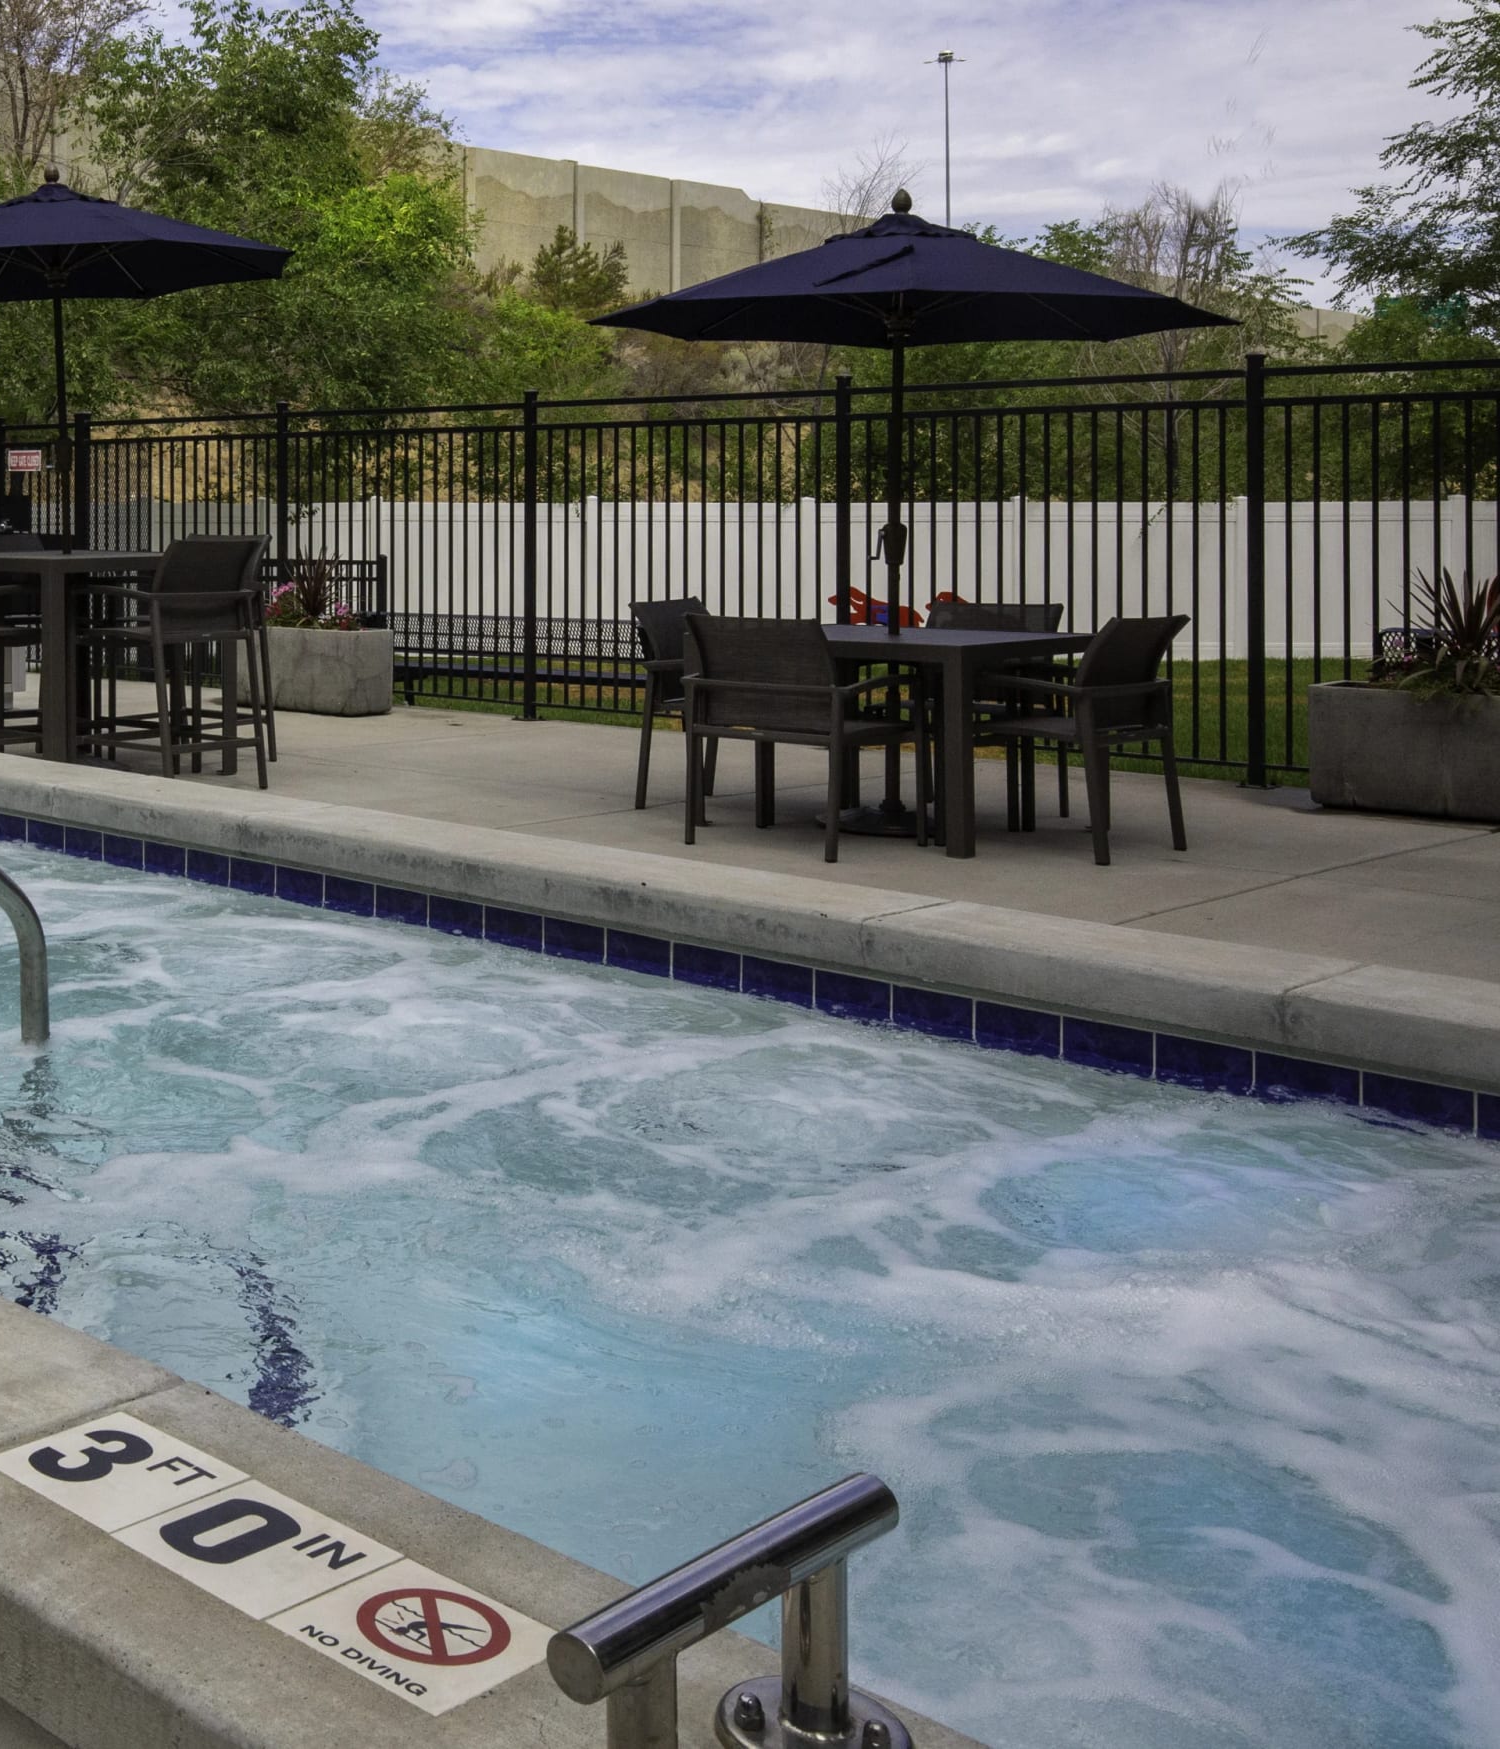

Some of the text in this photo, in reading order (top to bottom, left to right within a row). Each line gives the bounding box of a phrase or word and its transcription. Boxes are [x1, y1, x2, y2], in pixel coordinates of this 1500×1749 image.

[28, 1430, 367, 1570] 3 FT 0 IN
[299, 1624, 428, 1697] NO DIVING
